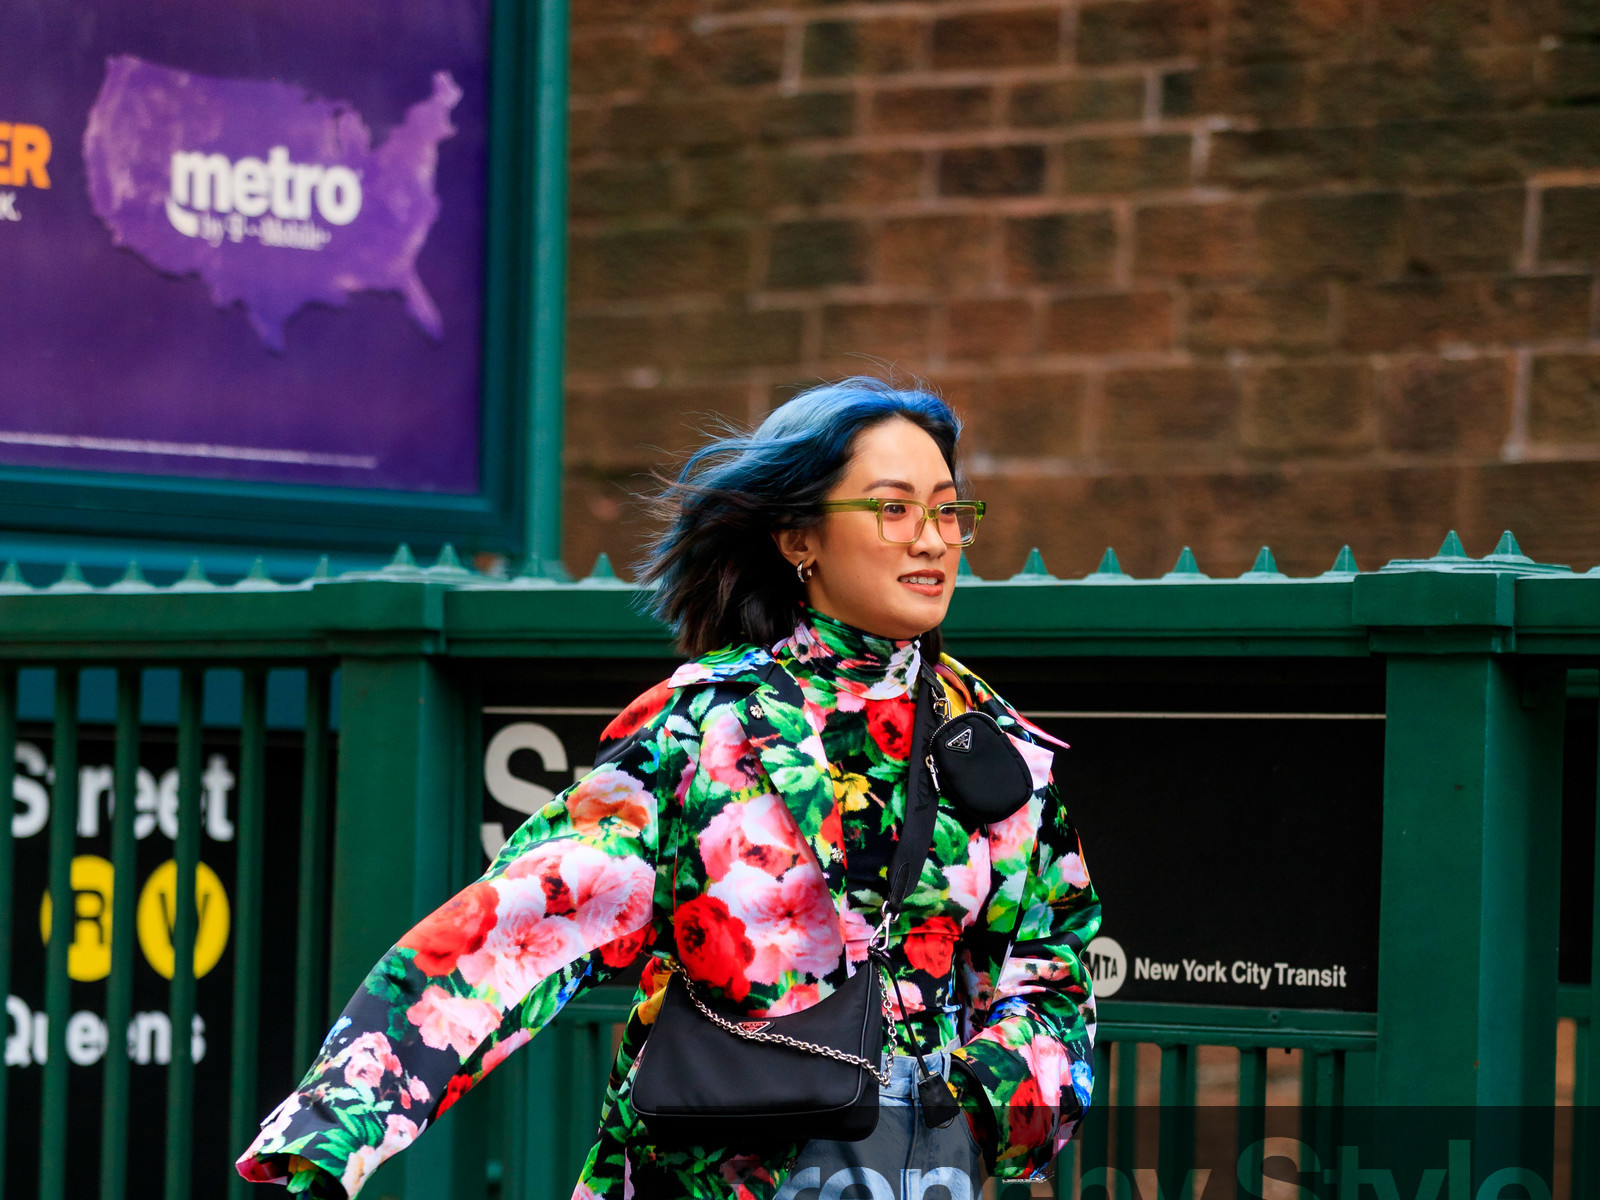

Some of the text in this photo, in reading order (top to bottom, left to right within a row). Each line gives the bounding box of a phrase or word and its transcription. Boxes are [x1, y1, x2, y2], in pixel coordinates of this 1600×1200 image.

[171, 146, 362, 226] metro
[11, 741, 235, 842] Sreet
[1134, 956, 1347, 991] New York City Transit
